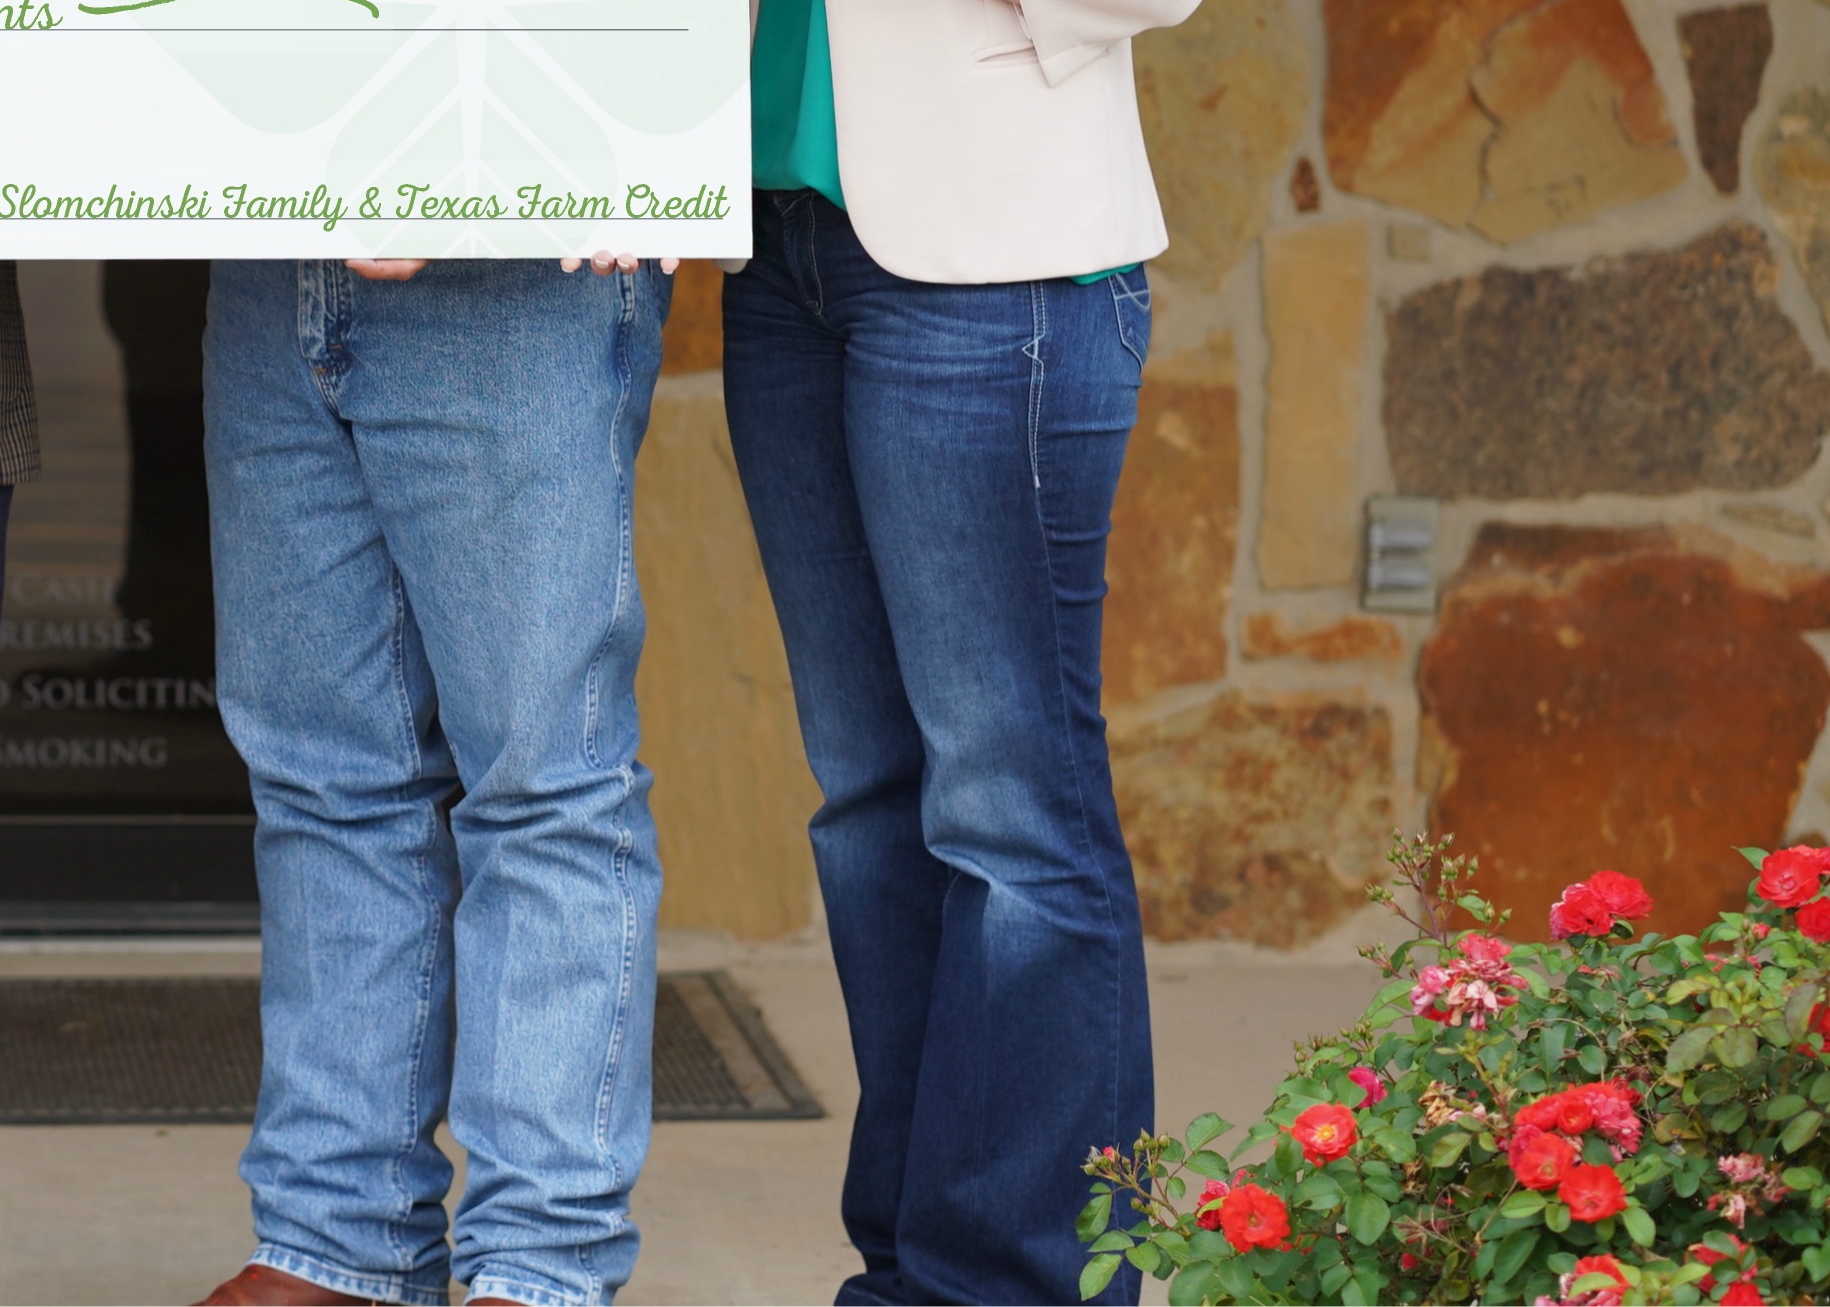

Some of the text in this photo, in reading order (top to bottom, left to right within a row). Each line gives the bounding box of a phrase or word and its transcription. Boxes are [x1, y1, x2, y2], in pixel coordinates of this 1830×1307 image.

[222, 182, 349, 233] Family
[358, 185, 383, 220] &
[394, 182, 509, 220] Texas
[516, 182, 616, 220] Farm
[624, 182, 732, 220] Credit
[21, 673, 217, 710] SOLICITIN
